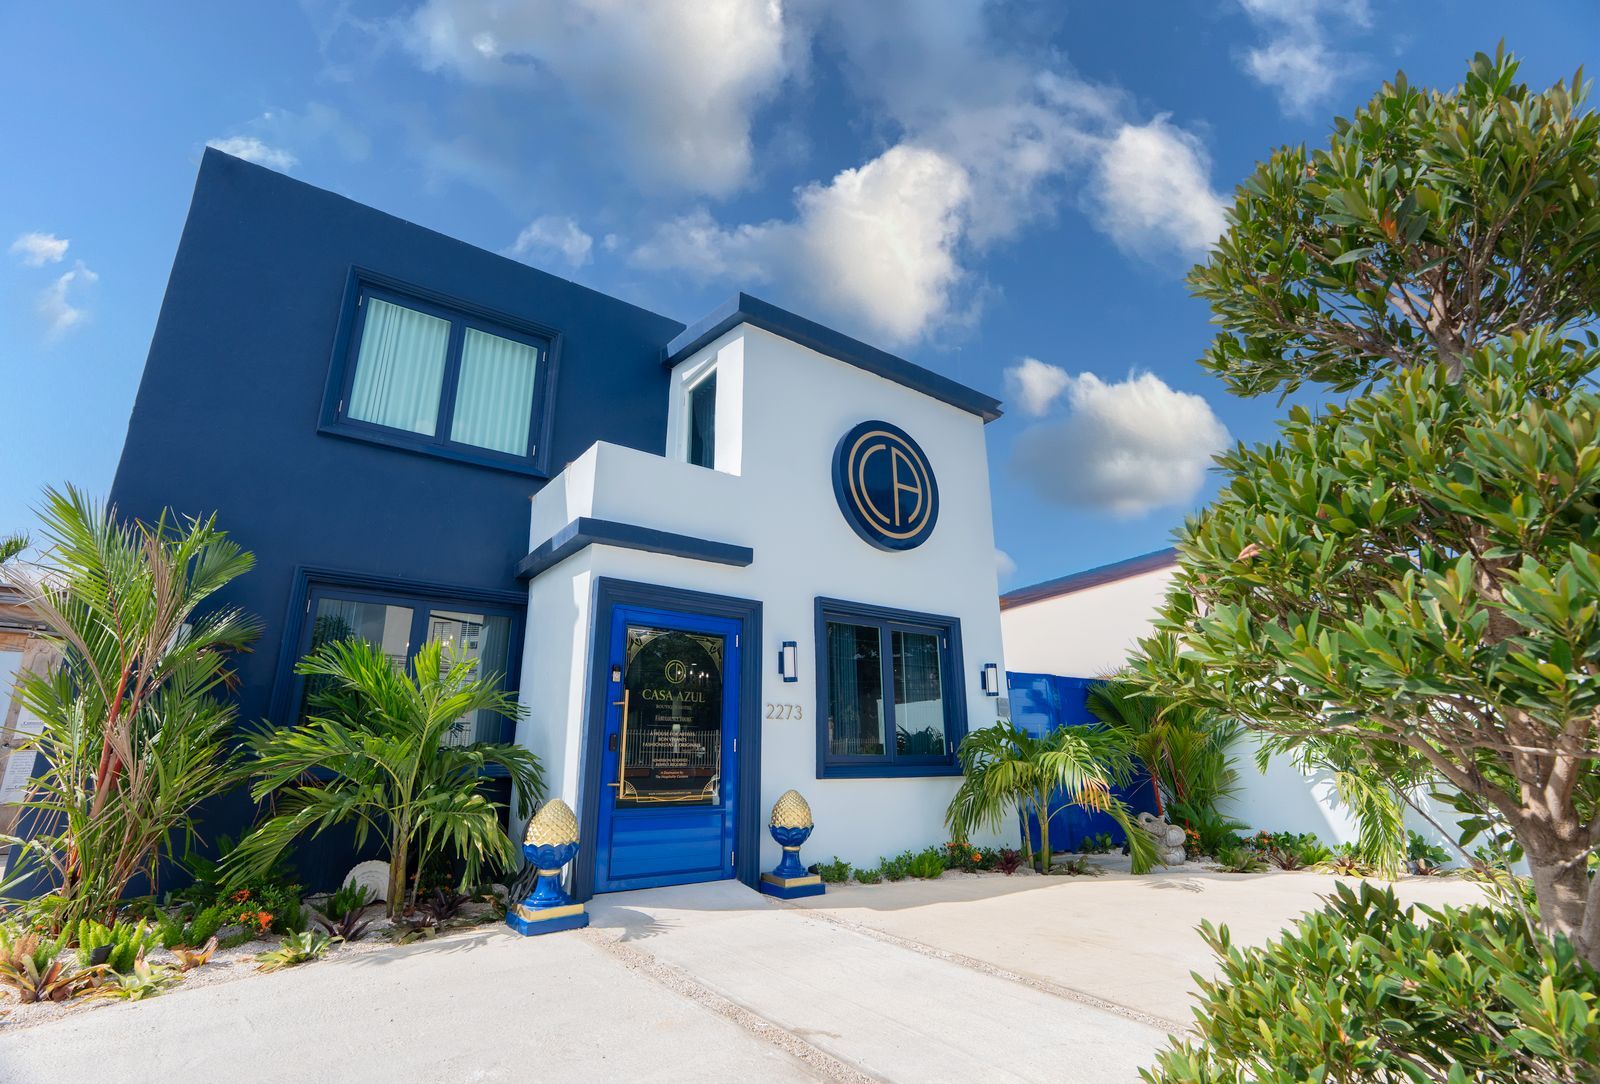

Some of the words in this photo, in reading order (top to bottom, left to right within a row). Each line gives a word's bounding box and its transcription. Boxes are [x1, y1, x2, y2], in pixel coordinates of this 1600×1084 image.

[642, 688, 673, 701] CASA
[676, 690, 705, 703] AZUL
[766, 703, 803, 721] 2273
